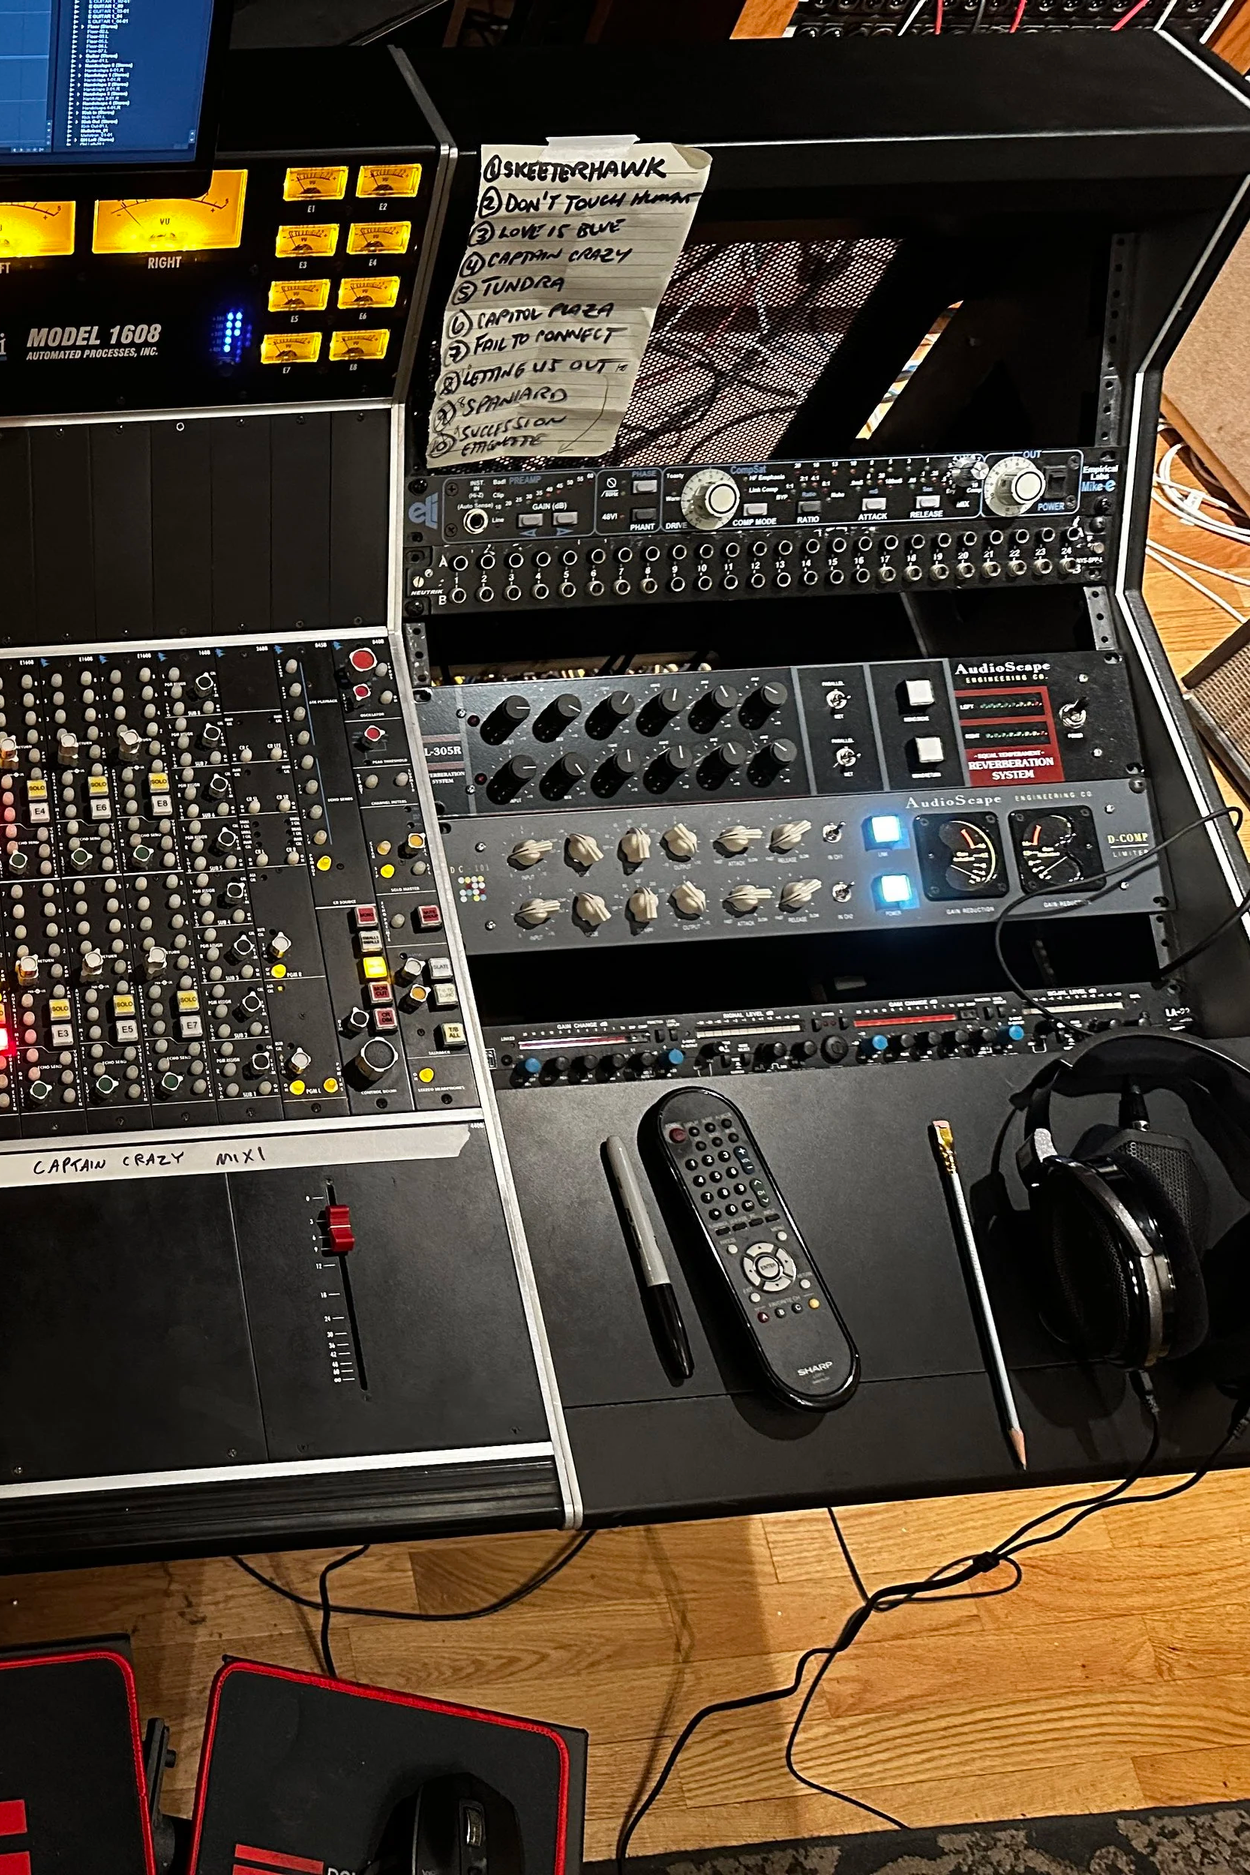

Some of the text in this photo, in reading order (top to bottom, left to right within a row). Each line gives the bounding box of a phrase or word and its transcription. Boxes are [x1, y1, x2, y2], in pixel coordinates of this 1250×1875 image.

[503, 157, 667, 182] SKEETERHAWK
[379, 203, 388, 211] E2
[505, 191, 561, 214] DON'T
[565, 193, 627, 214] TOUCH
[307, 205, 315, 213] E1
[159, 218, 171, 226] VU
[498, 223, 546, 239] LOVE
[548, 224, 571, 238] IS
[577, 219, 626, 238] BLUE
[148, 256, 182, 269] RIGHT
[487, 248, 562, 267] CAPTAIN
[568, 248, 633, 263] CRAZY
[299, 261, 307, 269] E3
[481, 276, 565, 296] TUNDRA
[291, 315, 298, 323] E5
[478, 308, 543, 329] CAPITOL
[548, 303, 614, 318] PLAZA
[26, 324, 162, 348] MODEL 1608
[473, 333, 508, 355] FAIL
[512, 333, 529, 349] TO
[535, 327, 629, 344] CONNECT
[26, 347, 159, 361] AUTOMATED PROCESSES, INC.
[532, 359, 563, 373] US
[569, 358, 623, 374] OUT
[464, 387, 568, 417] SPANIARD
[730, 465, 766, 474] CompSat
[1082, 465, 1118, 473] Empirical
[509, 476, 542, 485] PREAMP
[1038, 502, 1065, 510] POWER
[858, 513, 887, 521] ATTACK
[910, 510, 943, 518] RELEASE
[411, 588, 443, 596] NEUTRIK
[955, 662, 1050, 675] AudioScape
[966, 675, 1027, 684] ENGINEERING
[968, 757, 1054, 771] REVERBERATION
[992, 769, 1035, 780] SYSTEM
[157, 800, 168, 808] E8
[905, 794, 1002, 809] AudioScape
[1014, 792, 1076, 802] ENGINEERING
[35, 807, 46, 815] E4
[96, 804, 107, 812] E6
[1108, 833, 1148, 844] D-COMP
[187, 1021, 197, 1029] E7
[57, 1030, 69, 1038] E3
[33, 1156, 106, 1175] CAPTAIN
[122, 1151, 185, 1167] CRAZY
[797, 1361, 833, 1376] SHARP
